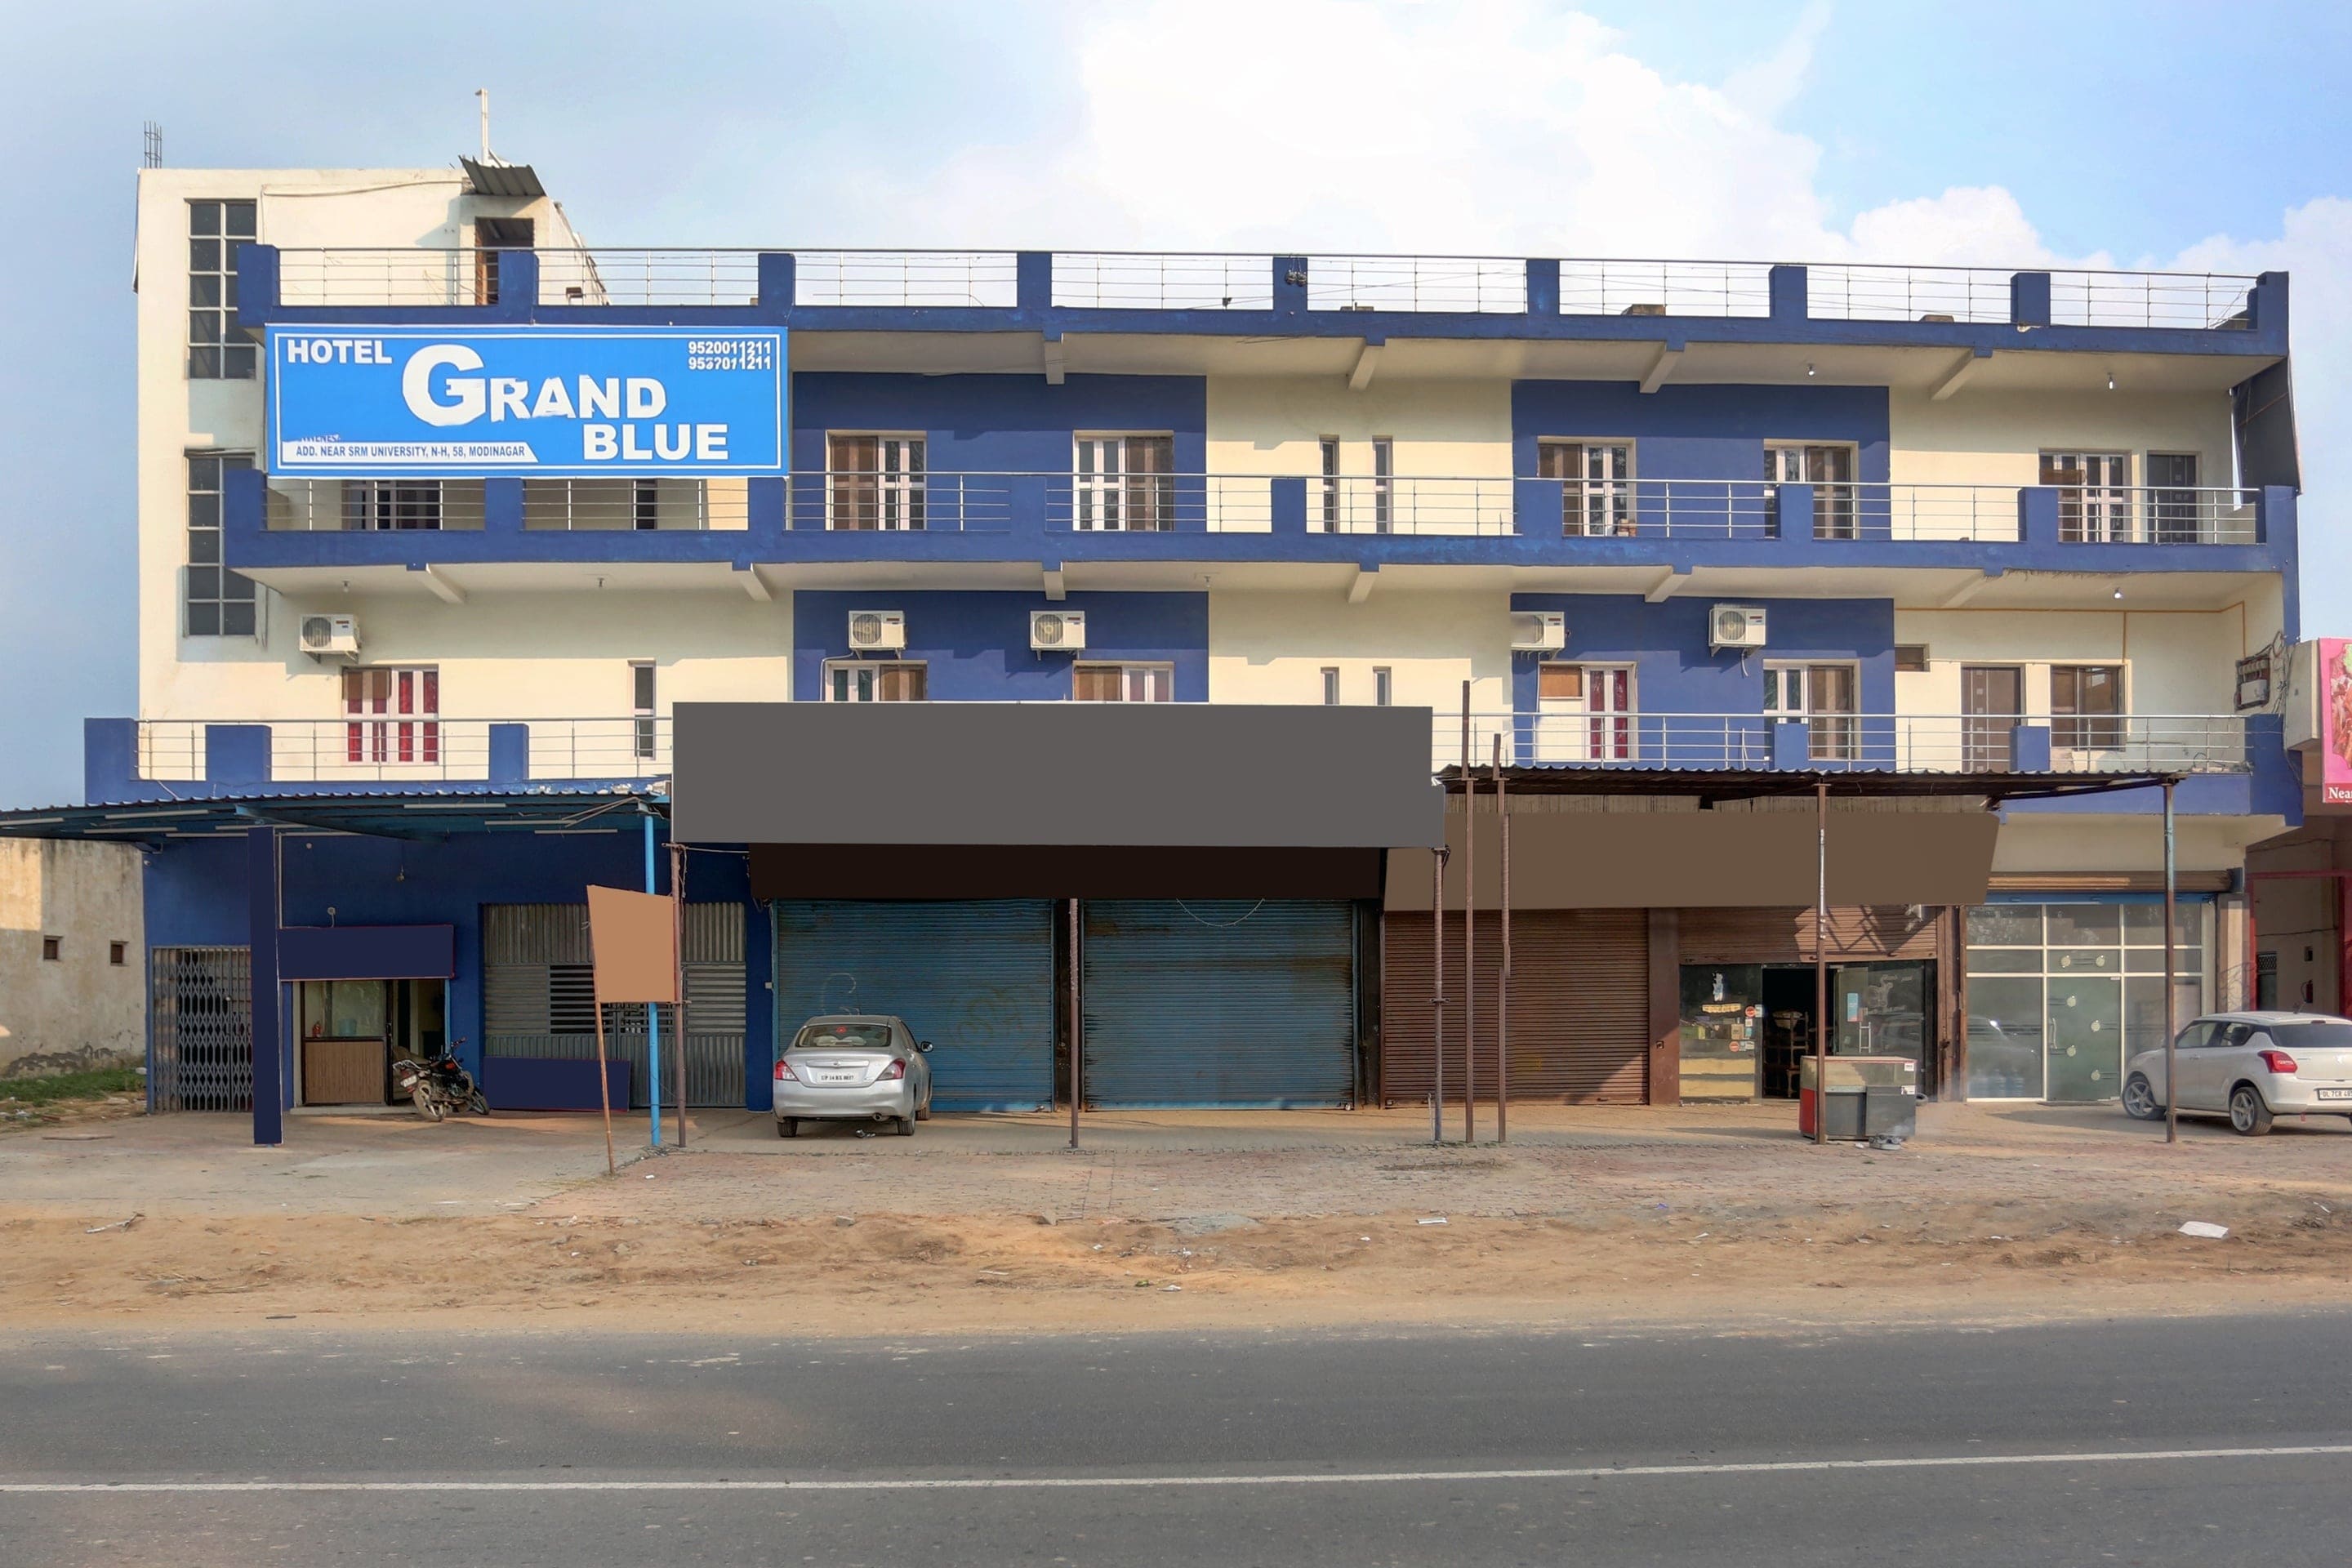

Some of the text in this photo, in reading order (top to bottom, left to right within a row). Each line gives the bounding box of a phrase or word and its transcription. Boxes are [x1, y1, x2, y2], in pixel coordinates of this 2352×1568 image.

[287, 339, 392, 365] HOTEL
[688, 341, 771, 354] 9520011211
[401, 343, 666, 425] GRAND
[582, 423, 728, 461] BLUE
[296, 446, 318, 457] ADD.
[320, 446, 345, 457] NEAR
[349, 446, 368, 457] SRM
[371, 446, 429, 458] UNIVERSITY,
[452, 446, 466, 458] 58,
[469, 446, 525, 457] MODINAGAR
[2328, 786, 2352, 799] Nea
